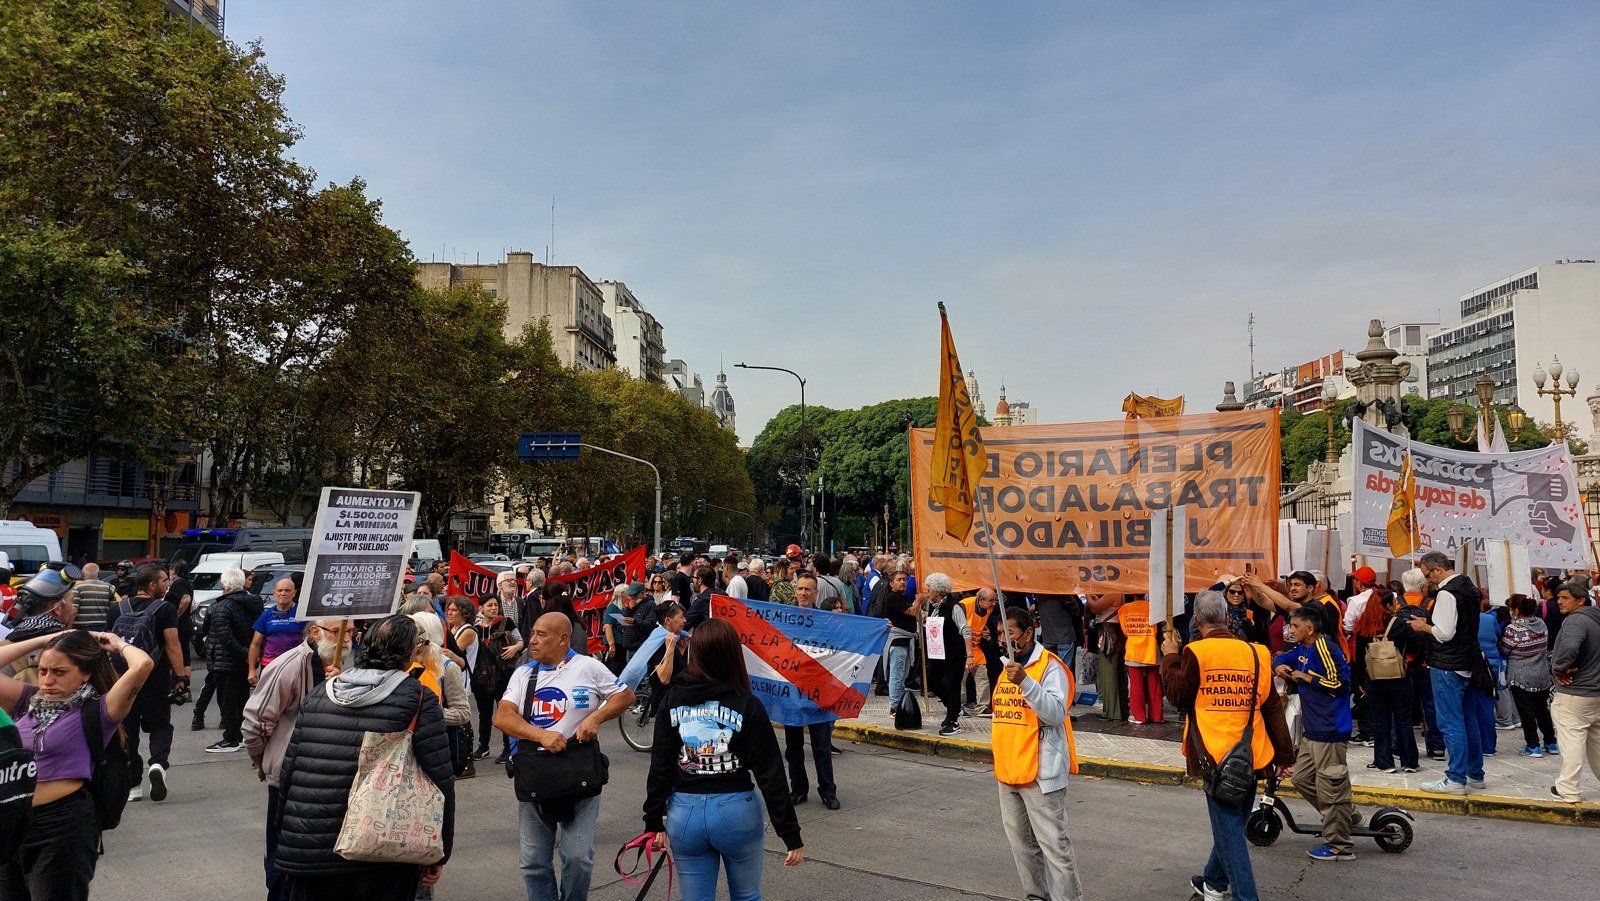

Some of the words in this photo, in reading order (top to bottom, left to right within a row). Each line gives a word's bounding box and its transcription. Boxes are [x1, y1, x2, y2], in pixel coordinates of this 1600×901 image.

[336, 496, 391, 507] AUMENTO
[393, 499, 406, 508] YA
[339, 510, 399, 520] $1.500.000
[335, 520, 351, 528] LA
[353, 521, 398, 529] MINIMA
[325, 533, 352, 541] AJUSTE
[353, 533, 367, 541] POR
[368, 532, 403, 542] INFLACIÓN
[358, 543, 389, 551] SUELDOS
[322, 572, 391, 580] TRABAJADORES
[321, 593, 354, 606] CSC
[712, 604, 737, 617] LOS
[745, 607, 814, 628] ENEMIGOS
[741, 633, 756, 645] DE
[760, 634, 779, 647] LA
[772, 655, 800, 673] SON
[797, 687, 804, 700] Y
[807, 688, 820, 701] LA
